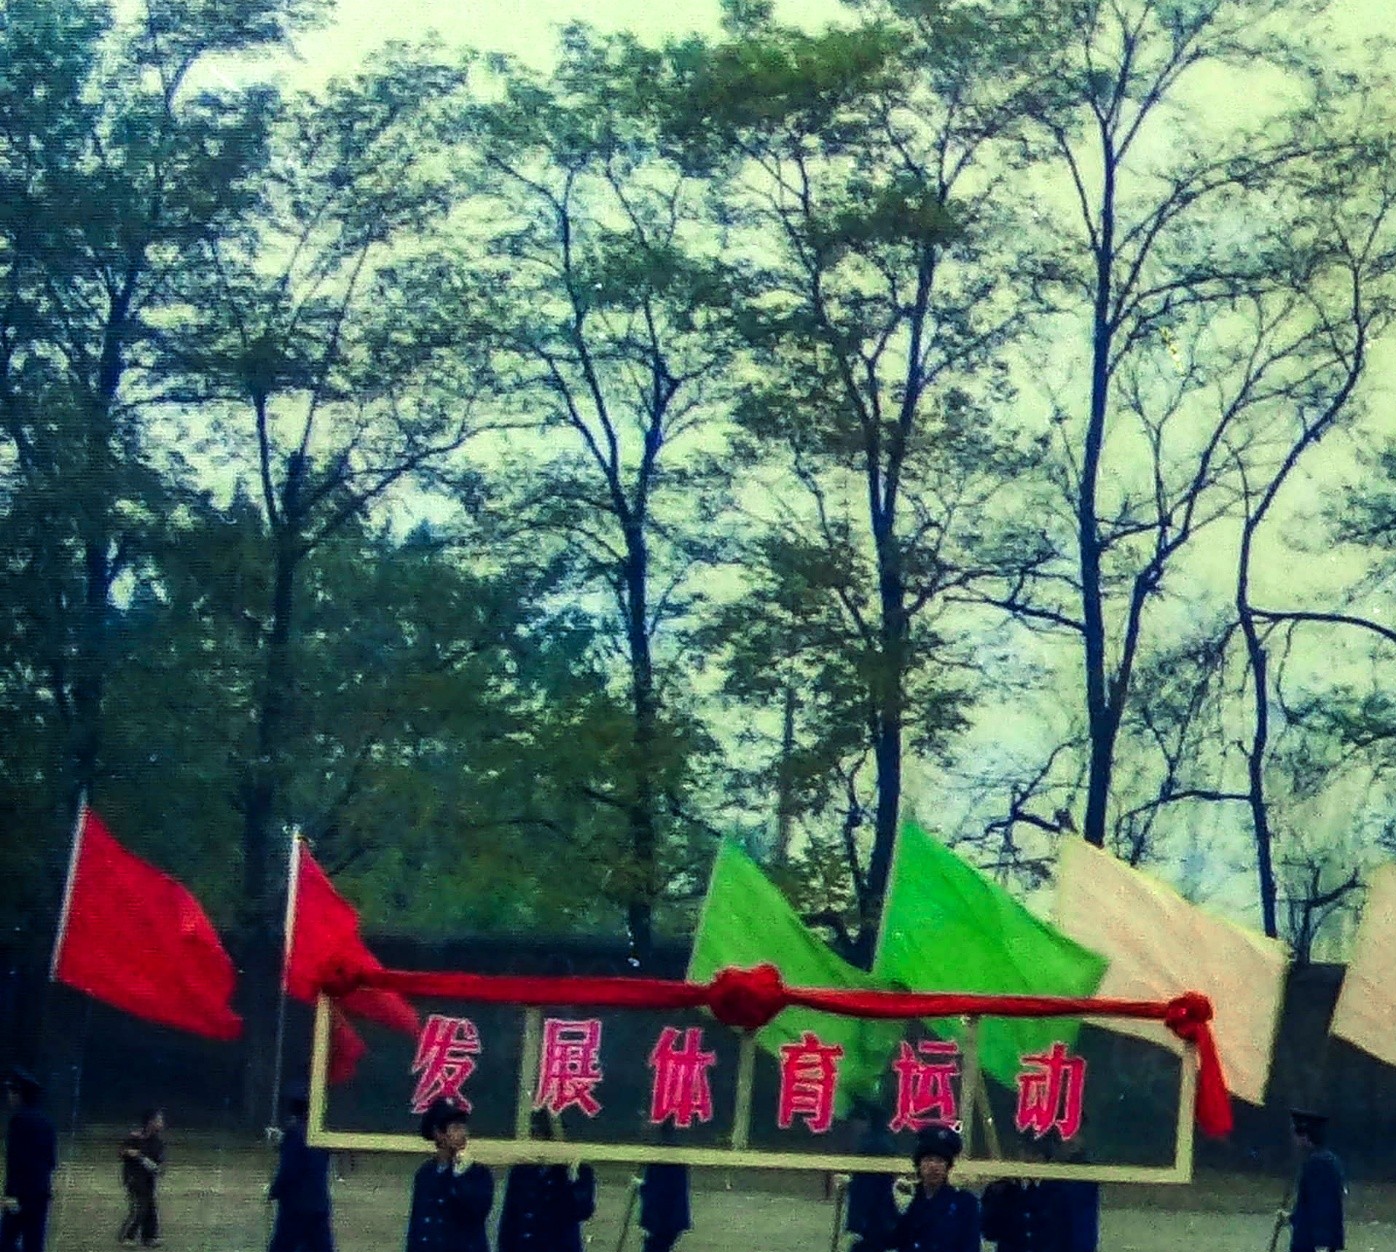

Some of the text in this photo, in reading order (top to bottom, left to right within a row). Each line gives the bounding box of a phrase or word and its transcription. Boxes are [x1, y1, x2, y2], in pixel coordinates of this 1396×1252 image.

[411, 1014, 1085, 1141] 发展体育运动
